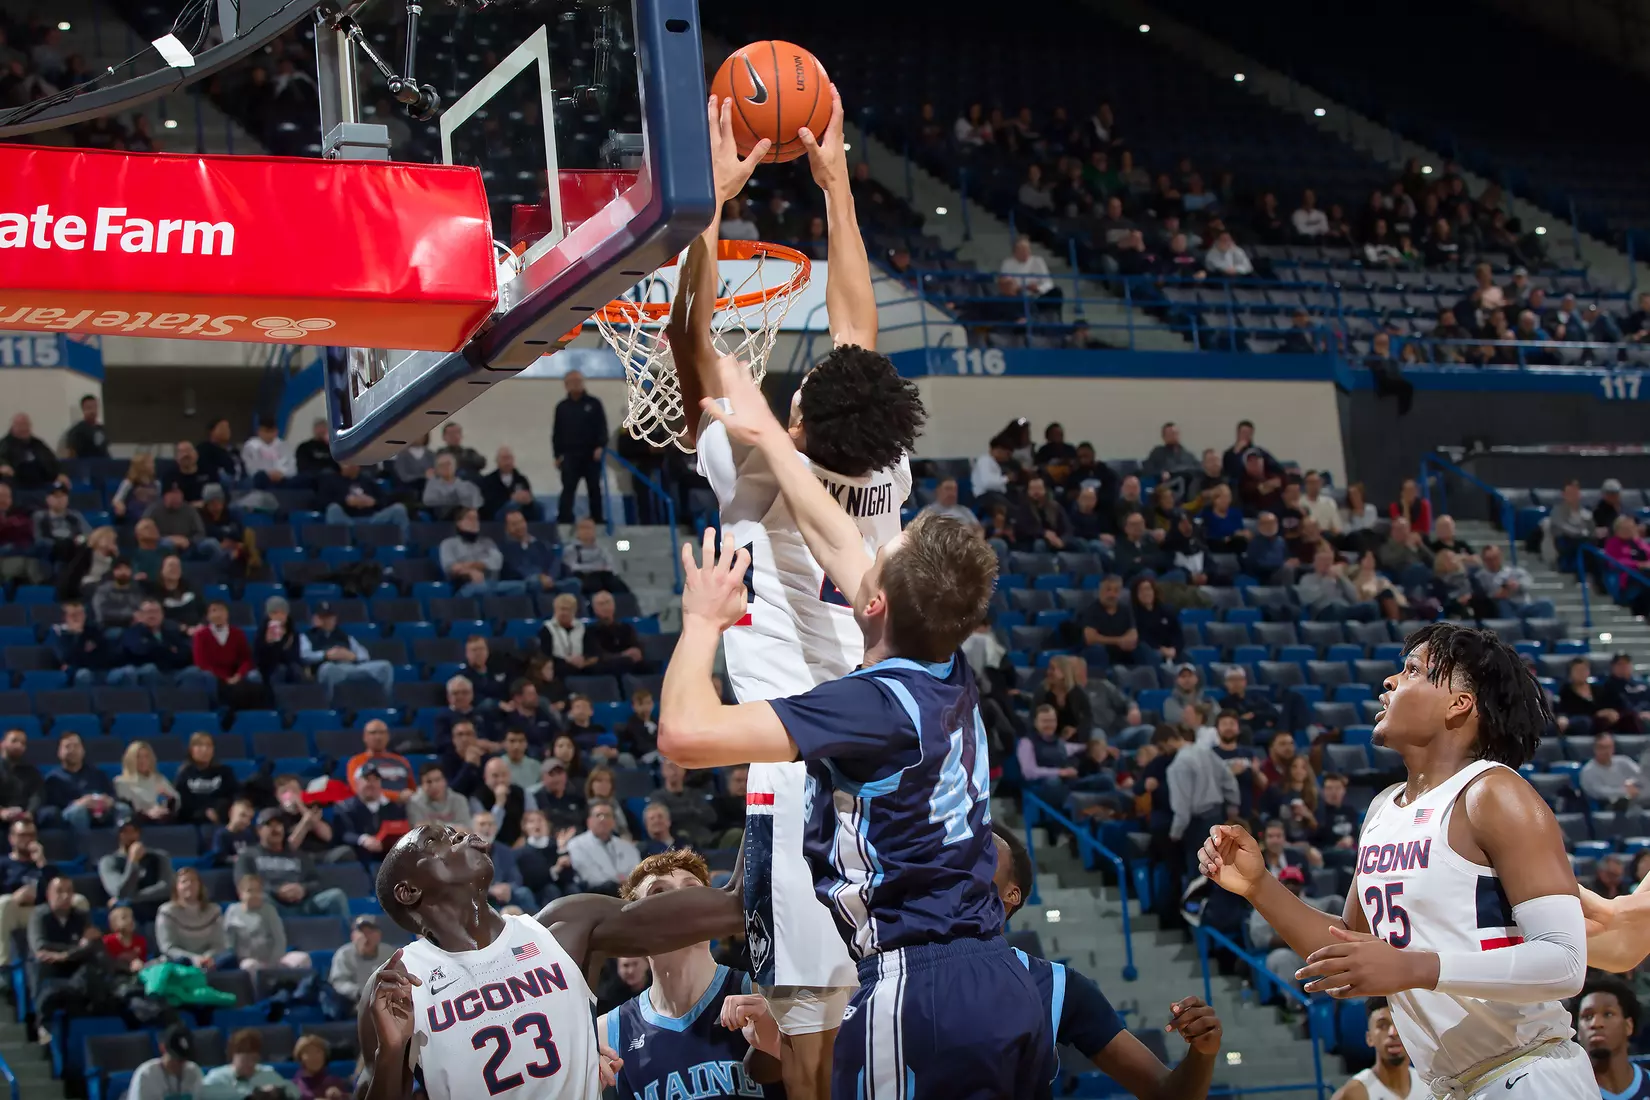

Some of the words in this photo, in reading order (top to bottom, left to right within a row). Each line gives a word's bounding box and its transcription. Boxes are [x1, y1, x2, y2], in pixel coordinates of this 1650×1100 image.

[793, 55, 805, 91] UCONN
[0, 337, 60, 367] 115
[952, 348, 1006, 375] 116
[1600, 371, 1642, 399] 117
[1364, 882, 1412, 949] 25
[427, 962, 568, 1032] UCONN
[471, 1012, 562, 1096] 23
